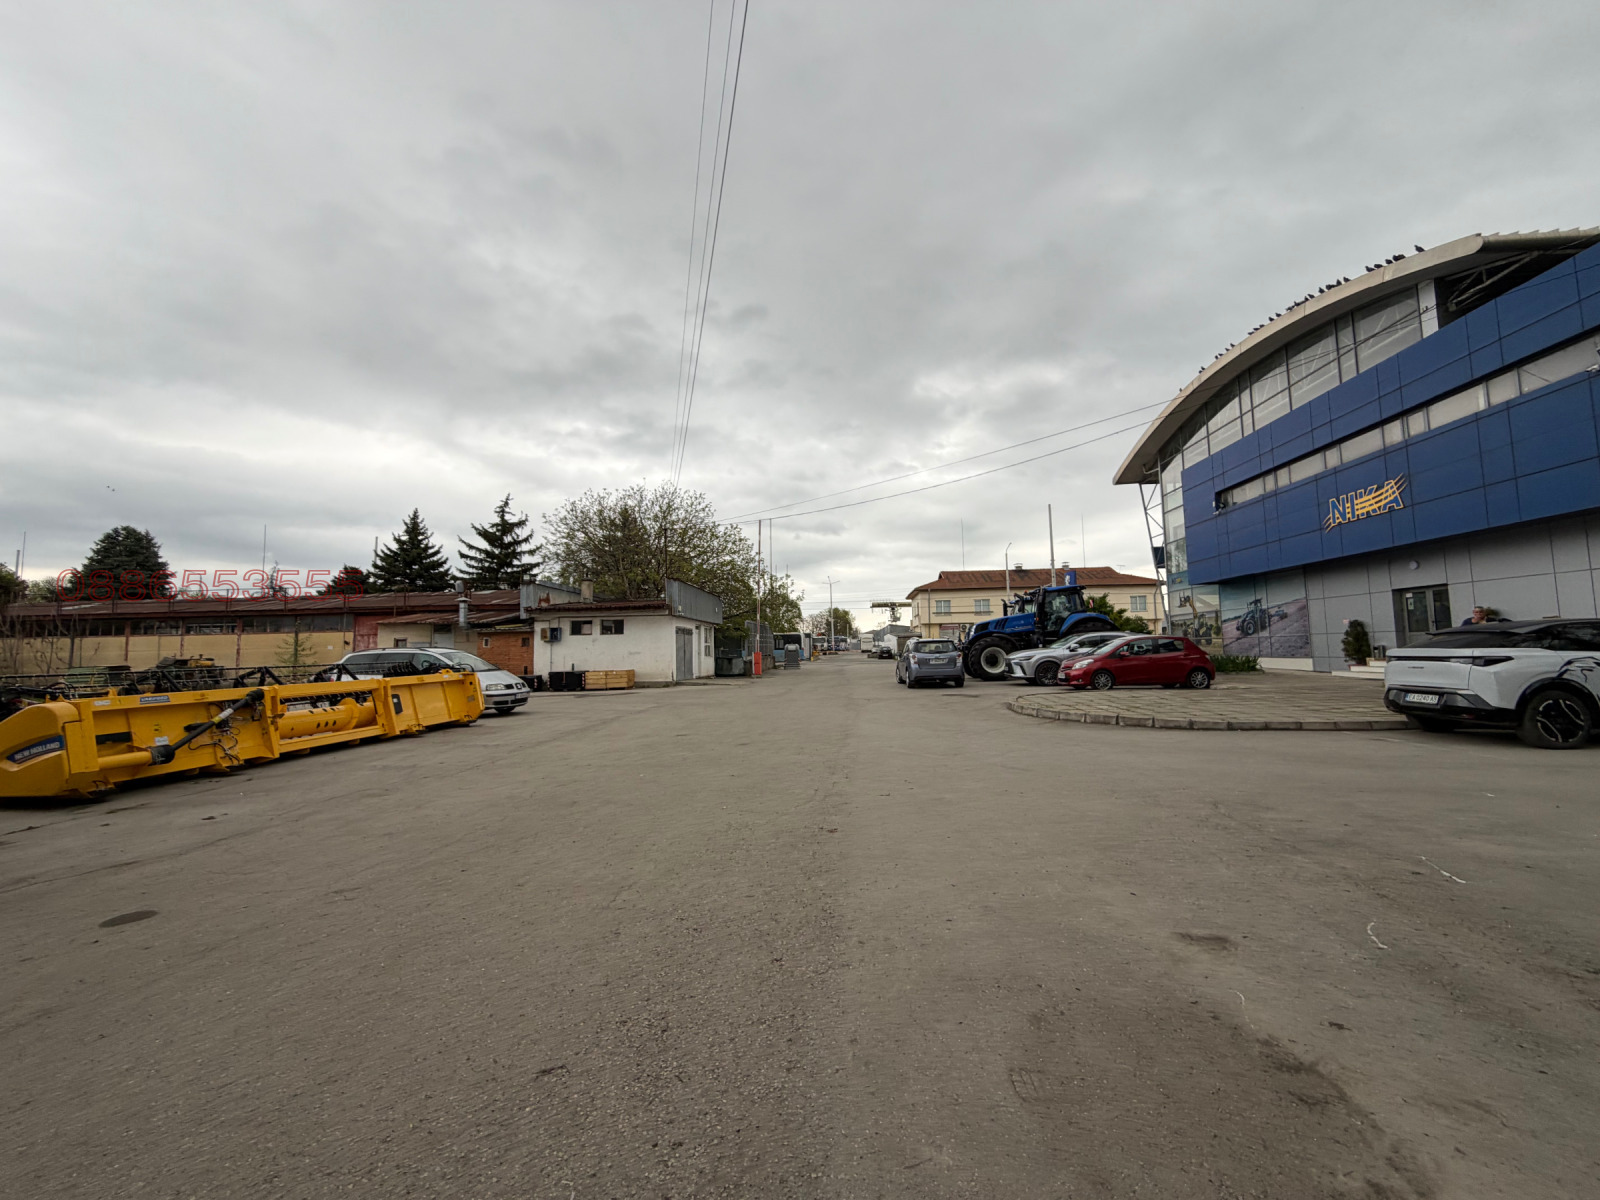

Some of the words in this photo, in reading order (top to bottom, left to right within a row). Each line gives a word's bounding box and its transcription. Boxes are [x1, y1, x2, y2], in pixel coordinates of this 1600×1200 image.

[1328, 479, 1404, 526] NIKA
[14, 749, 30, 761] NEW
[30, 741, 60, 755] HOLLAND
